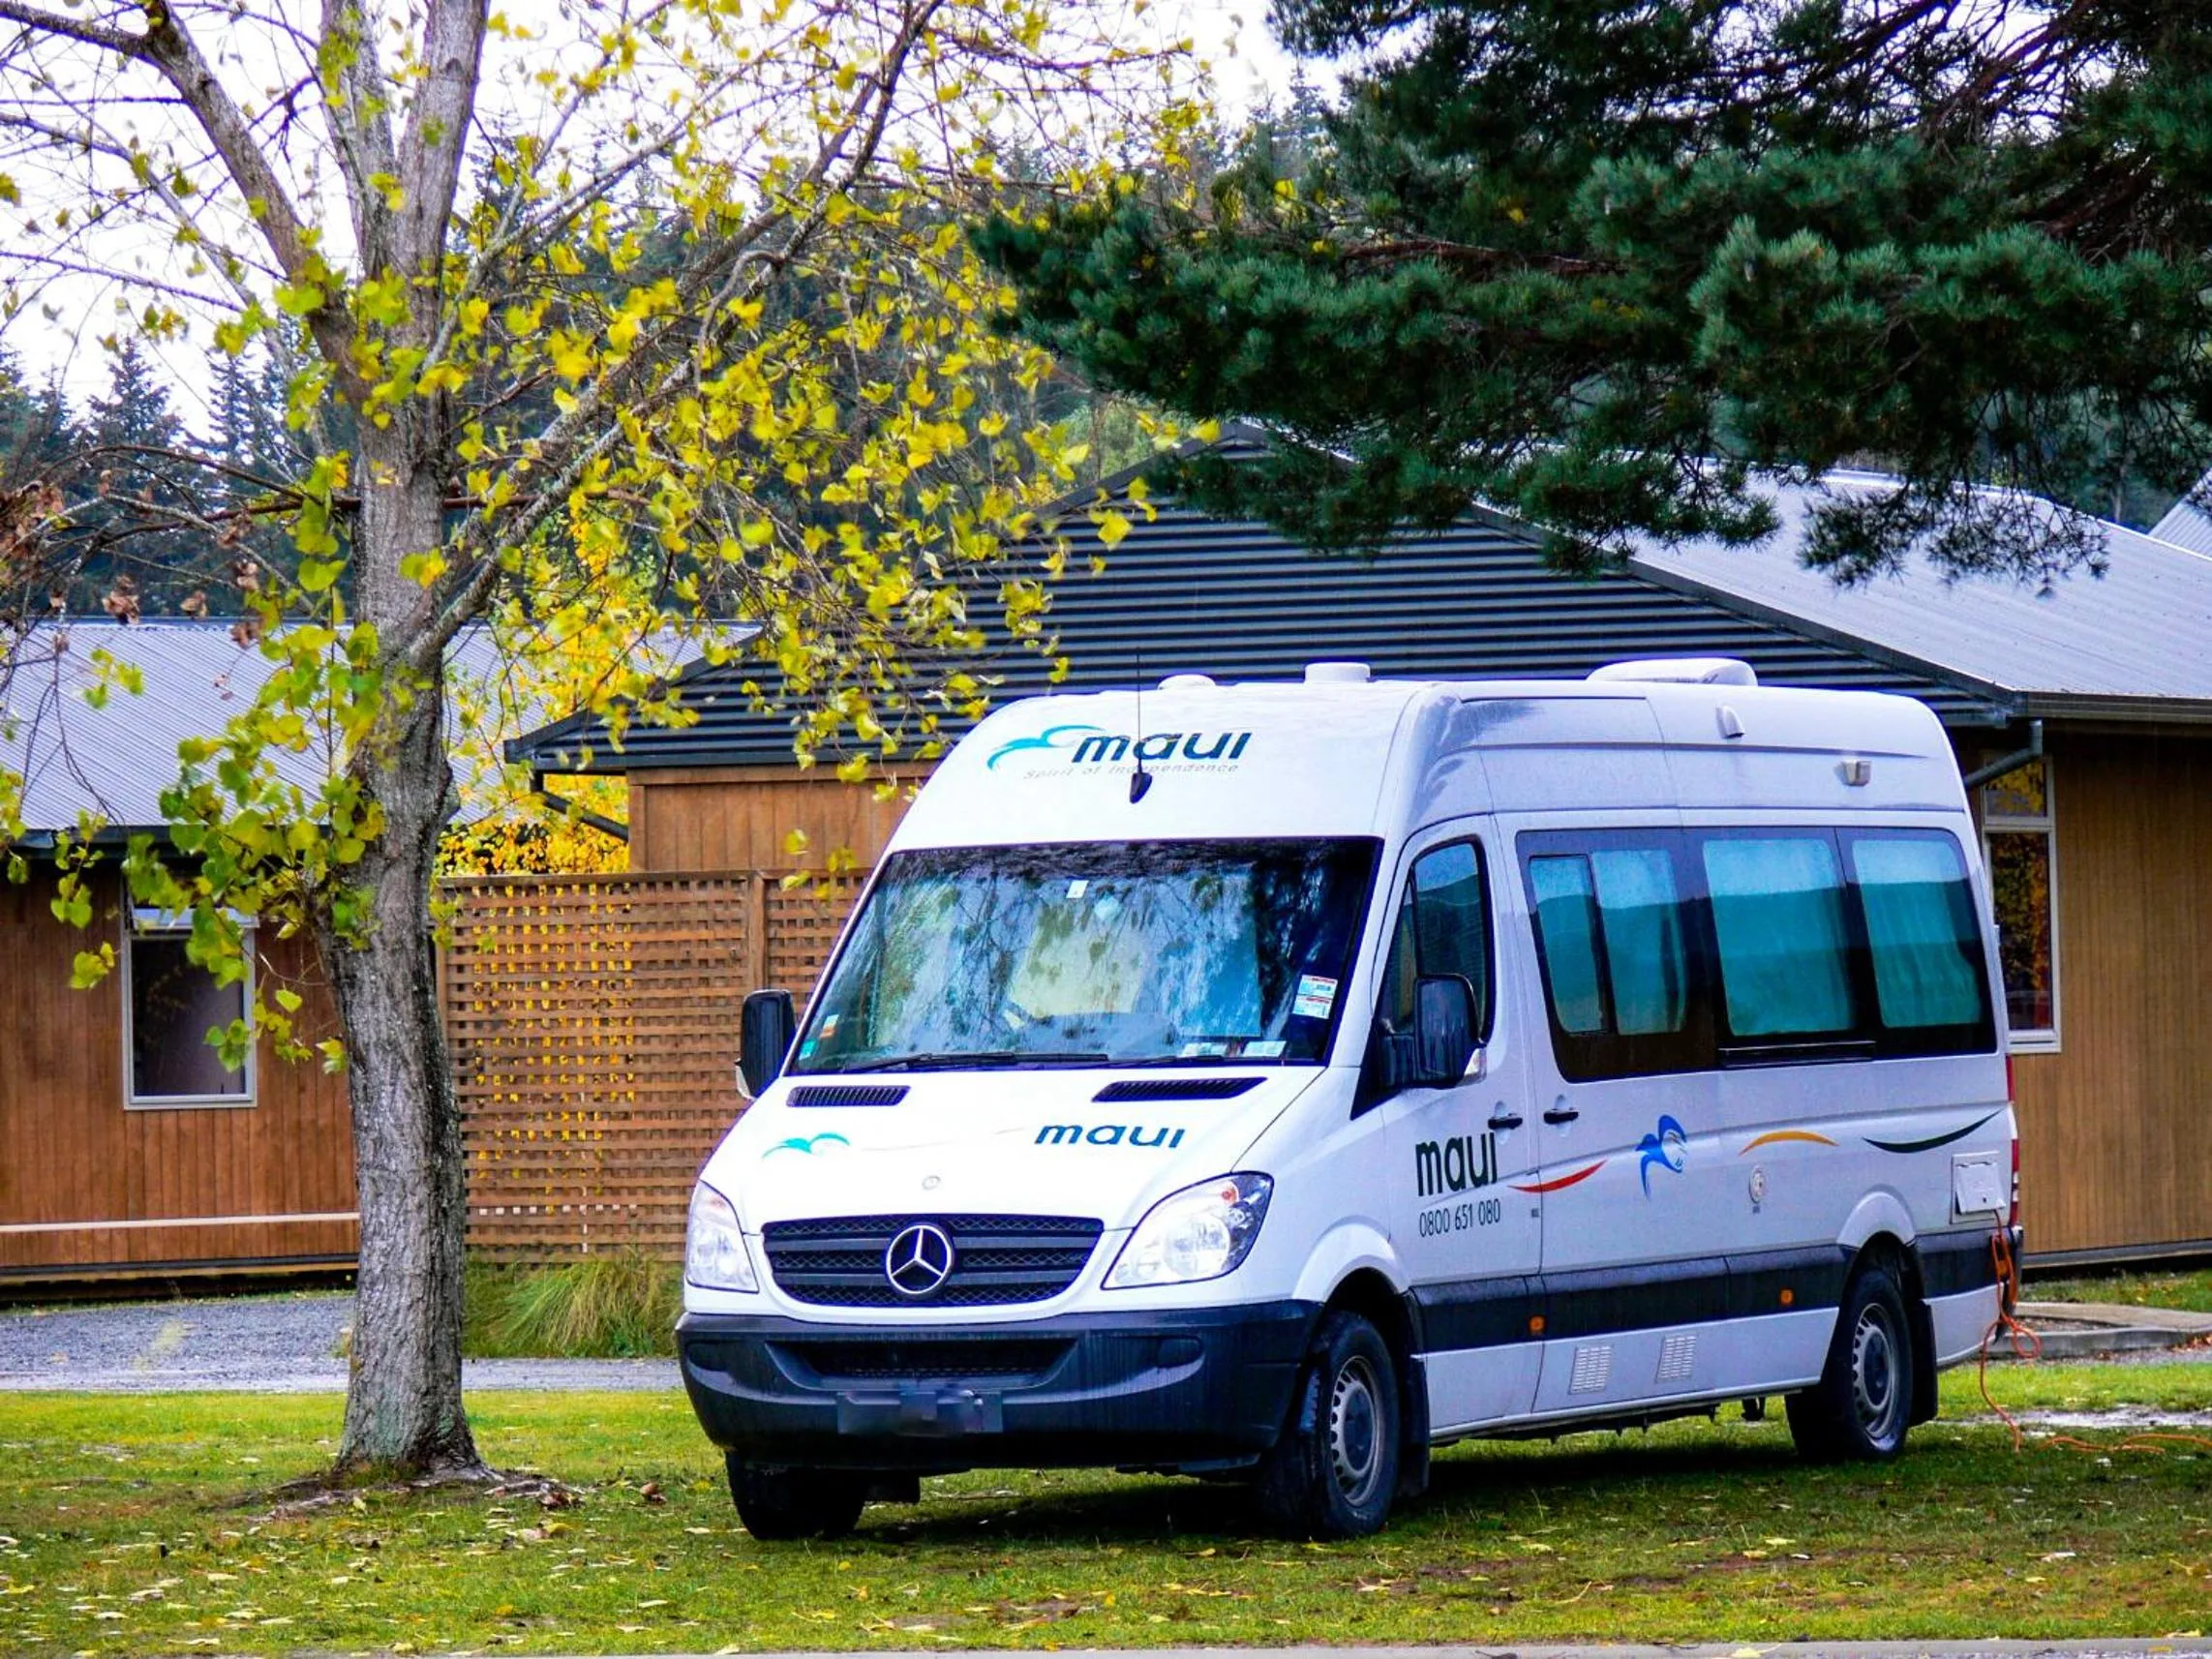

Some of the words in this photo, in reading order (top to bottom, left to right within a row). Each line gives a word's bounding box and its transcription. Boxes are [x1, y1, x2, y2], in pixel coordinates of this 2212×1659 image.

[1072, 732, 1252, 764] maui
[1034, 1125, 1186, 1148] maui
[1415, 1132, 1498, 1196] maui
[1419, 1207, 1450, 1237] 0800
[1455, 1203, 1473, 1230] 651
[1478, 1198, 1500, 1226] 080
